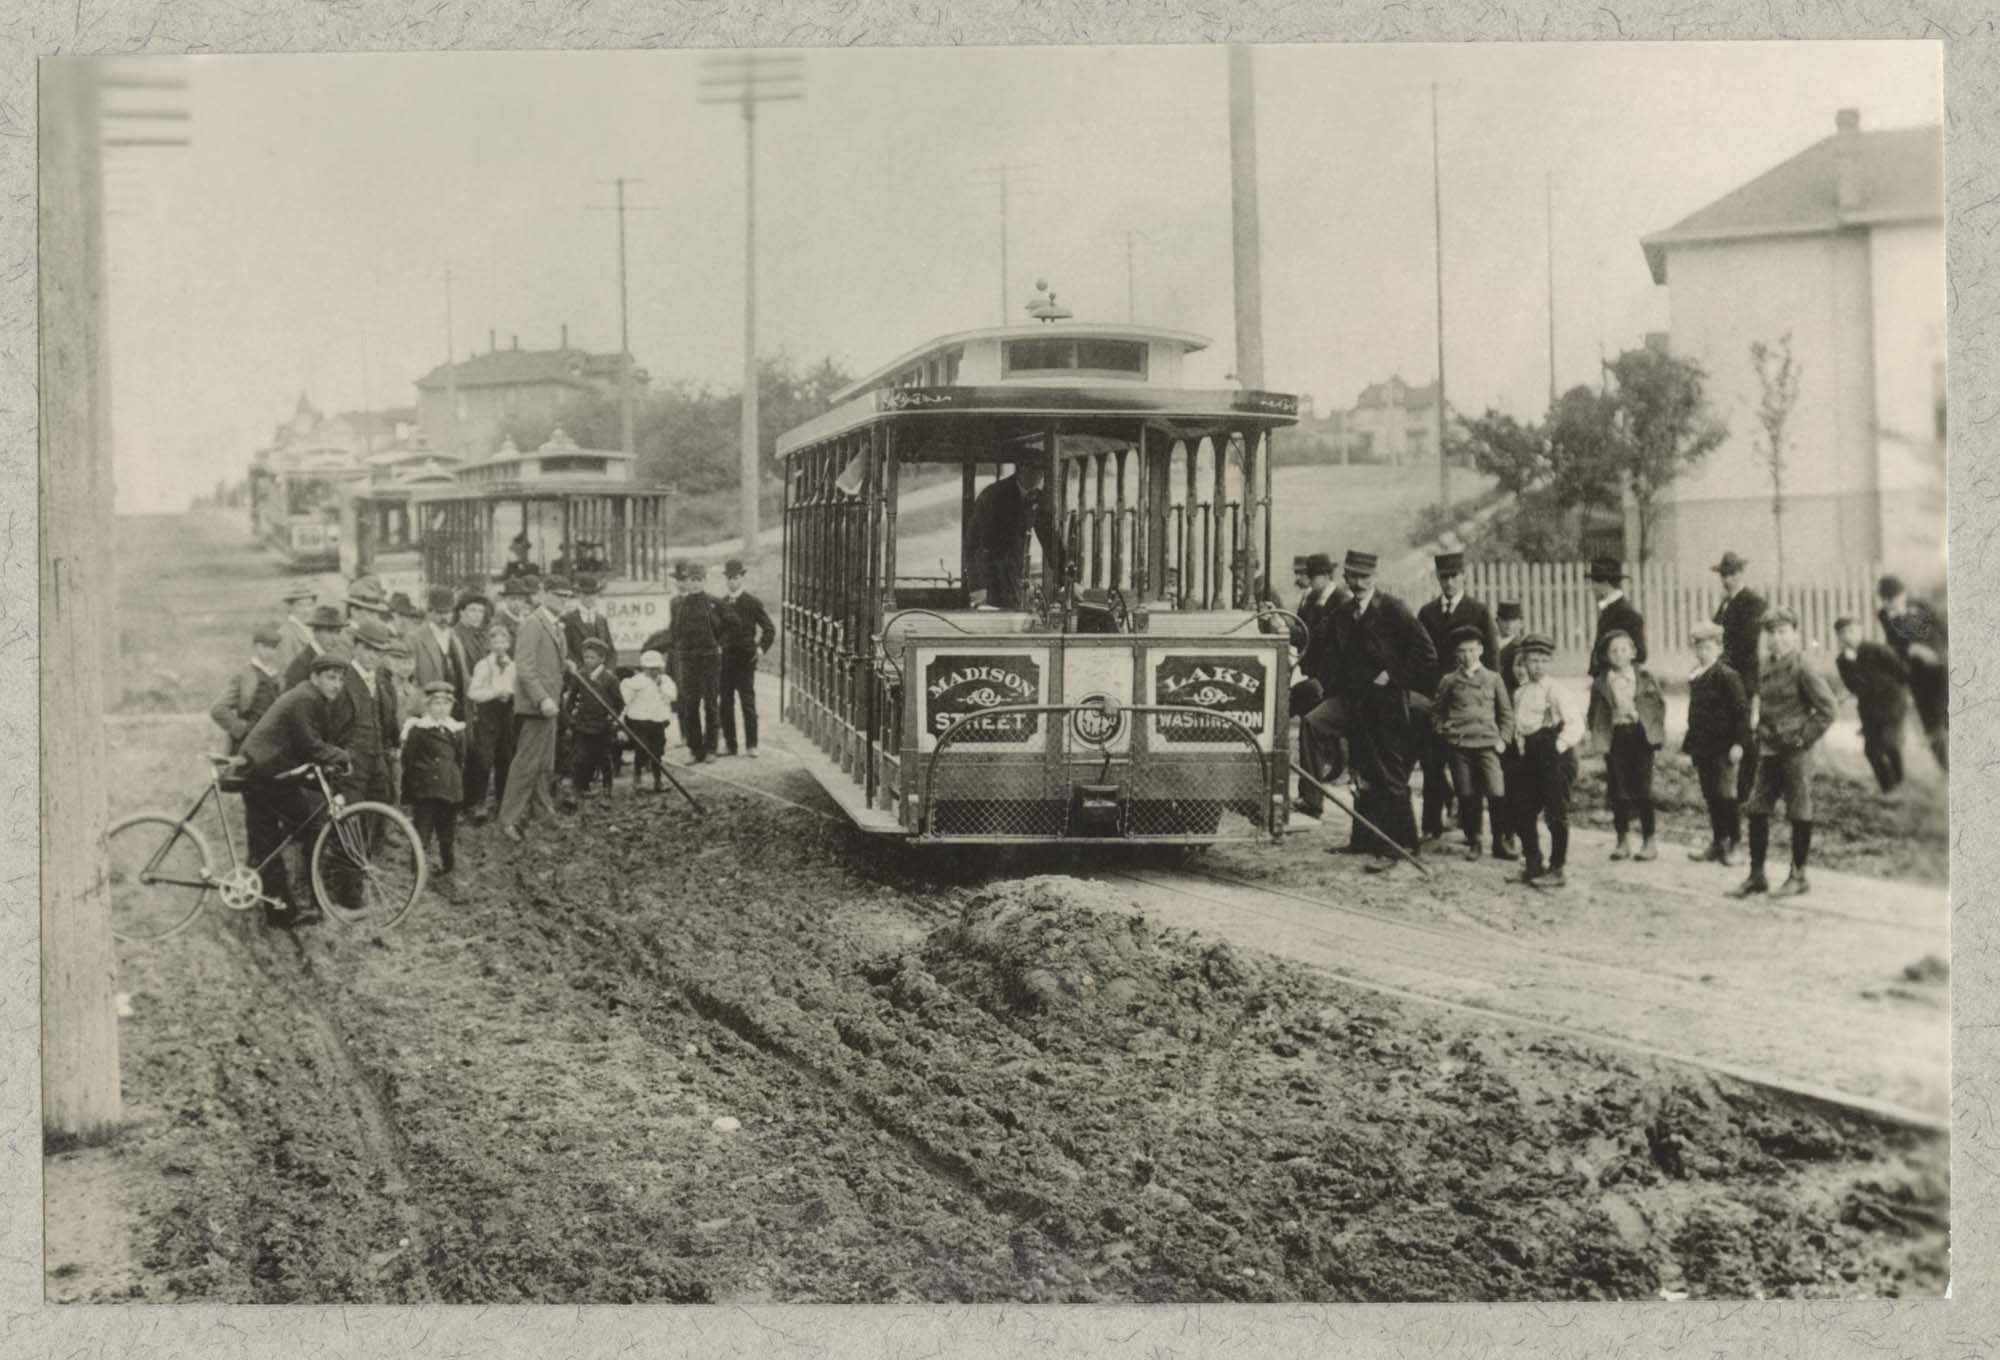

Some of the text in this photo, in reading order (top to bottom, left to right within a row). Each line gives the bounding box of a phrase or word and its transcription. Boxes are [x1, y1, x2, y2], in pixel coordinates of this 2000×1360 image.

[606, 600, 656, 617] BAND
[928, 666, 1036, 699] MADISON
[1164, 666, 1260, 693] LAKE
